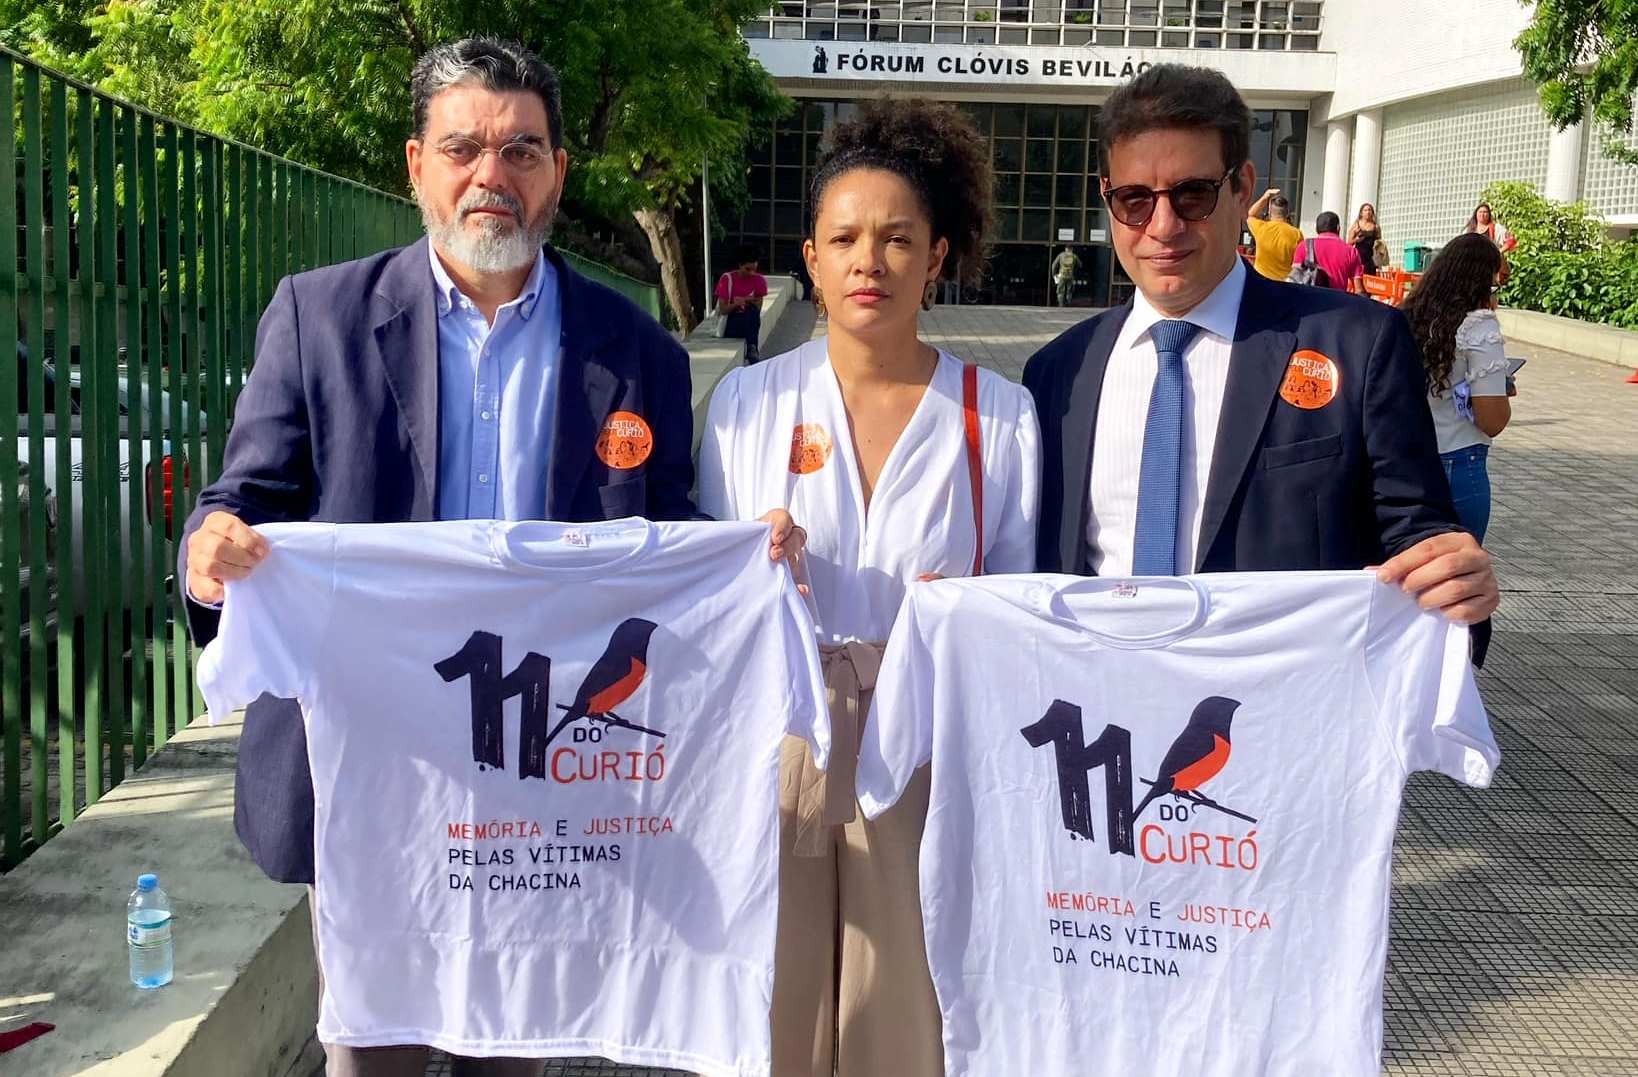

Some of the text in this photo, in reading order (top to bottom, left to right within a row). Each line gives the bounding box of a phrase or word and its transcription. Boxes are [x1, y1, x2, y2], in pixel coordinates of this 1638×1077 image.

[837, 48, 925, 73] FÓRUM
[937, 52, 1029, 75] CLÓVIS
[573, 727, 602, 743] DO
[1160, 804, 1189, 822] DO
[448, 816, 674, 839] MEMÓRIA E JUSTIÇA
[448, 843, 621, 865] PELAS VÍTIMAS
[449, 872, 581, 891] DA CHACINA
[1046, 892, 1271, 933] MEMÓRIA E JUSTIÇA
[1050, 919, 1217, 953] PELAS VÍTIMAS
[1053, 946, 1180, 977] DA CHACINA
